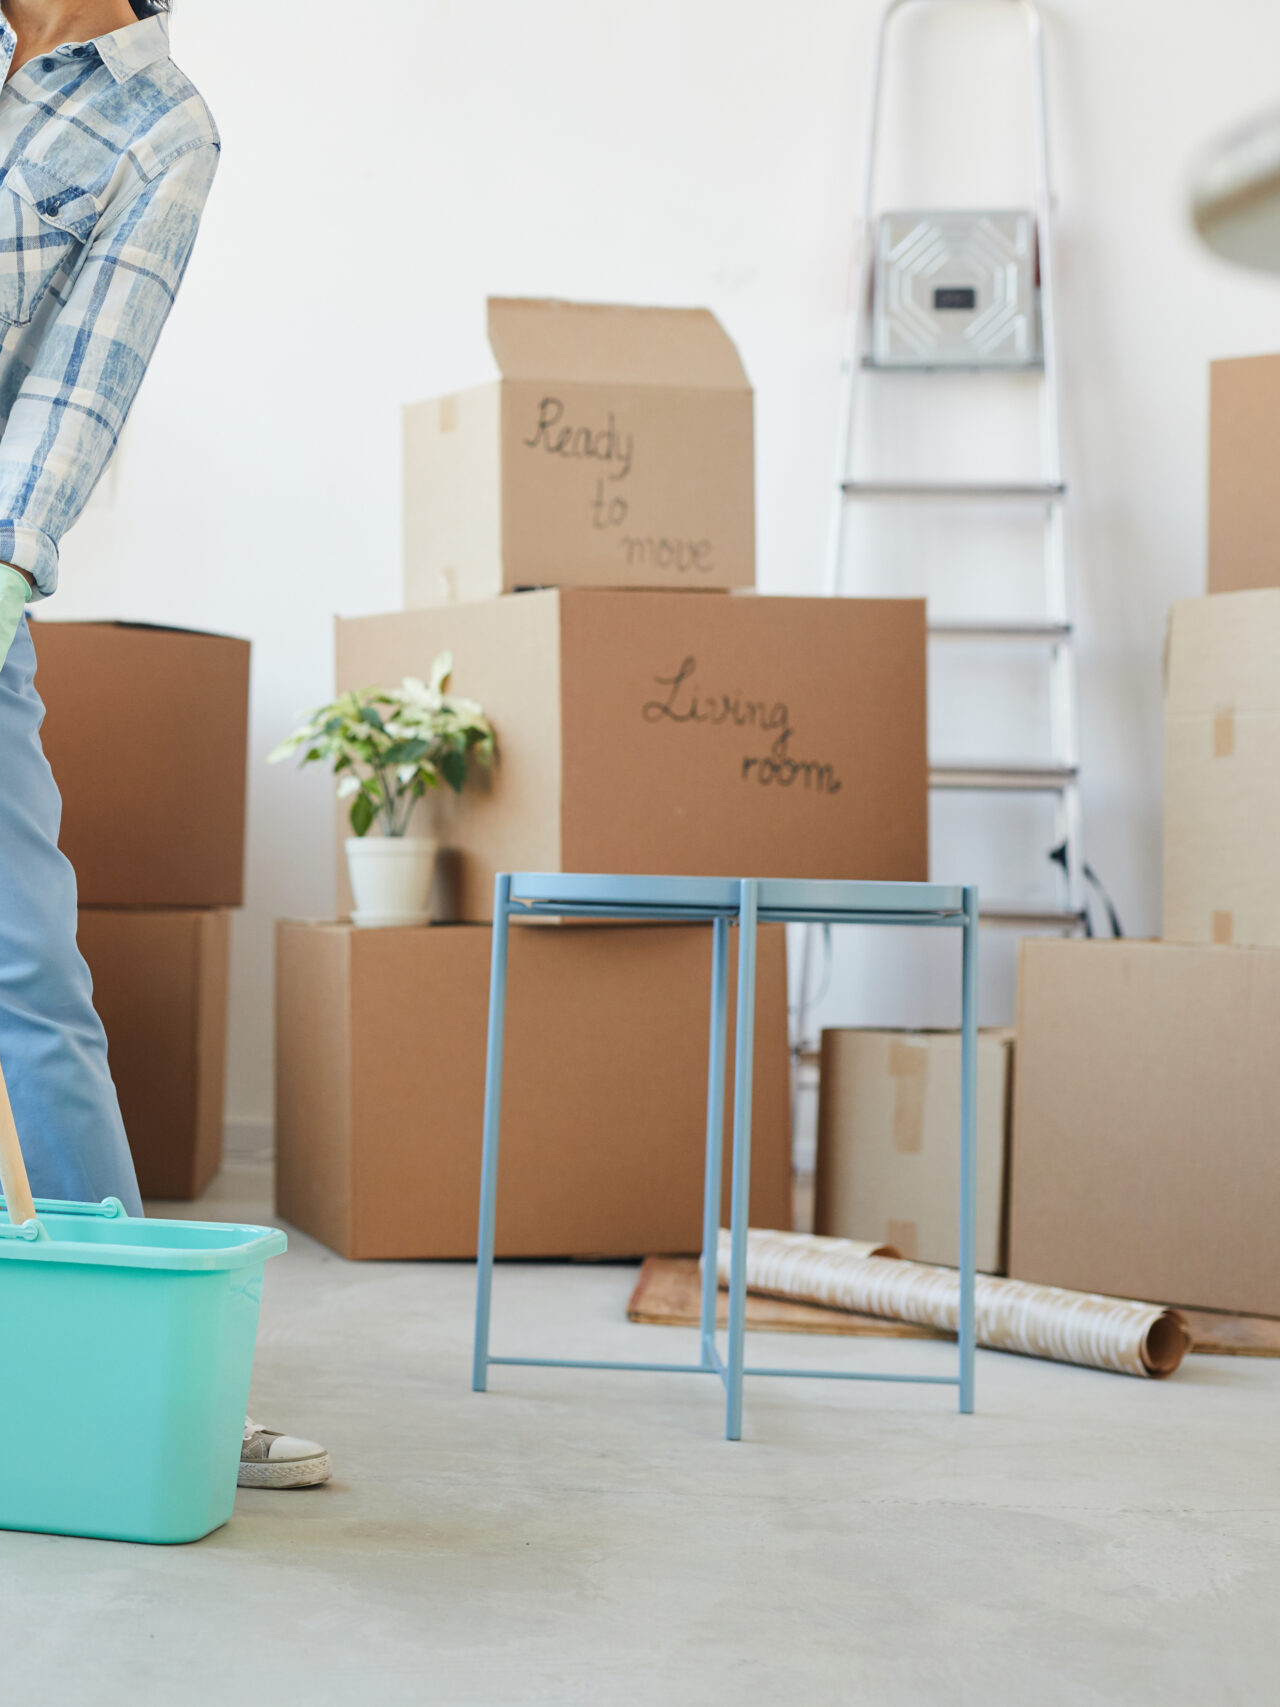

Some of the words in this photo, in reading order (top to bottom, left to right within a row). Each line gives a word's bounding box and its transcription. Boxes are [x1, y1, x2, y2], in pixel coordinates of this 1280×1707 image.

[523, 396, 634, 481] Ready
[592, 477, 629, 530] to
[621, 536, 714, 573] move
[642, 656, 793, 759] Living
